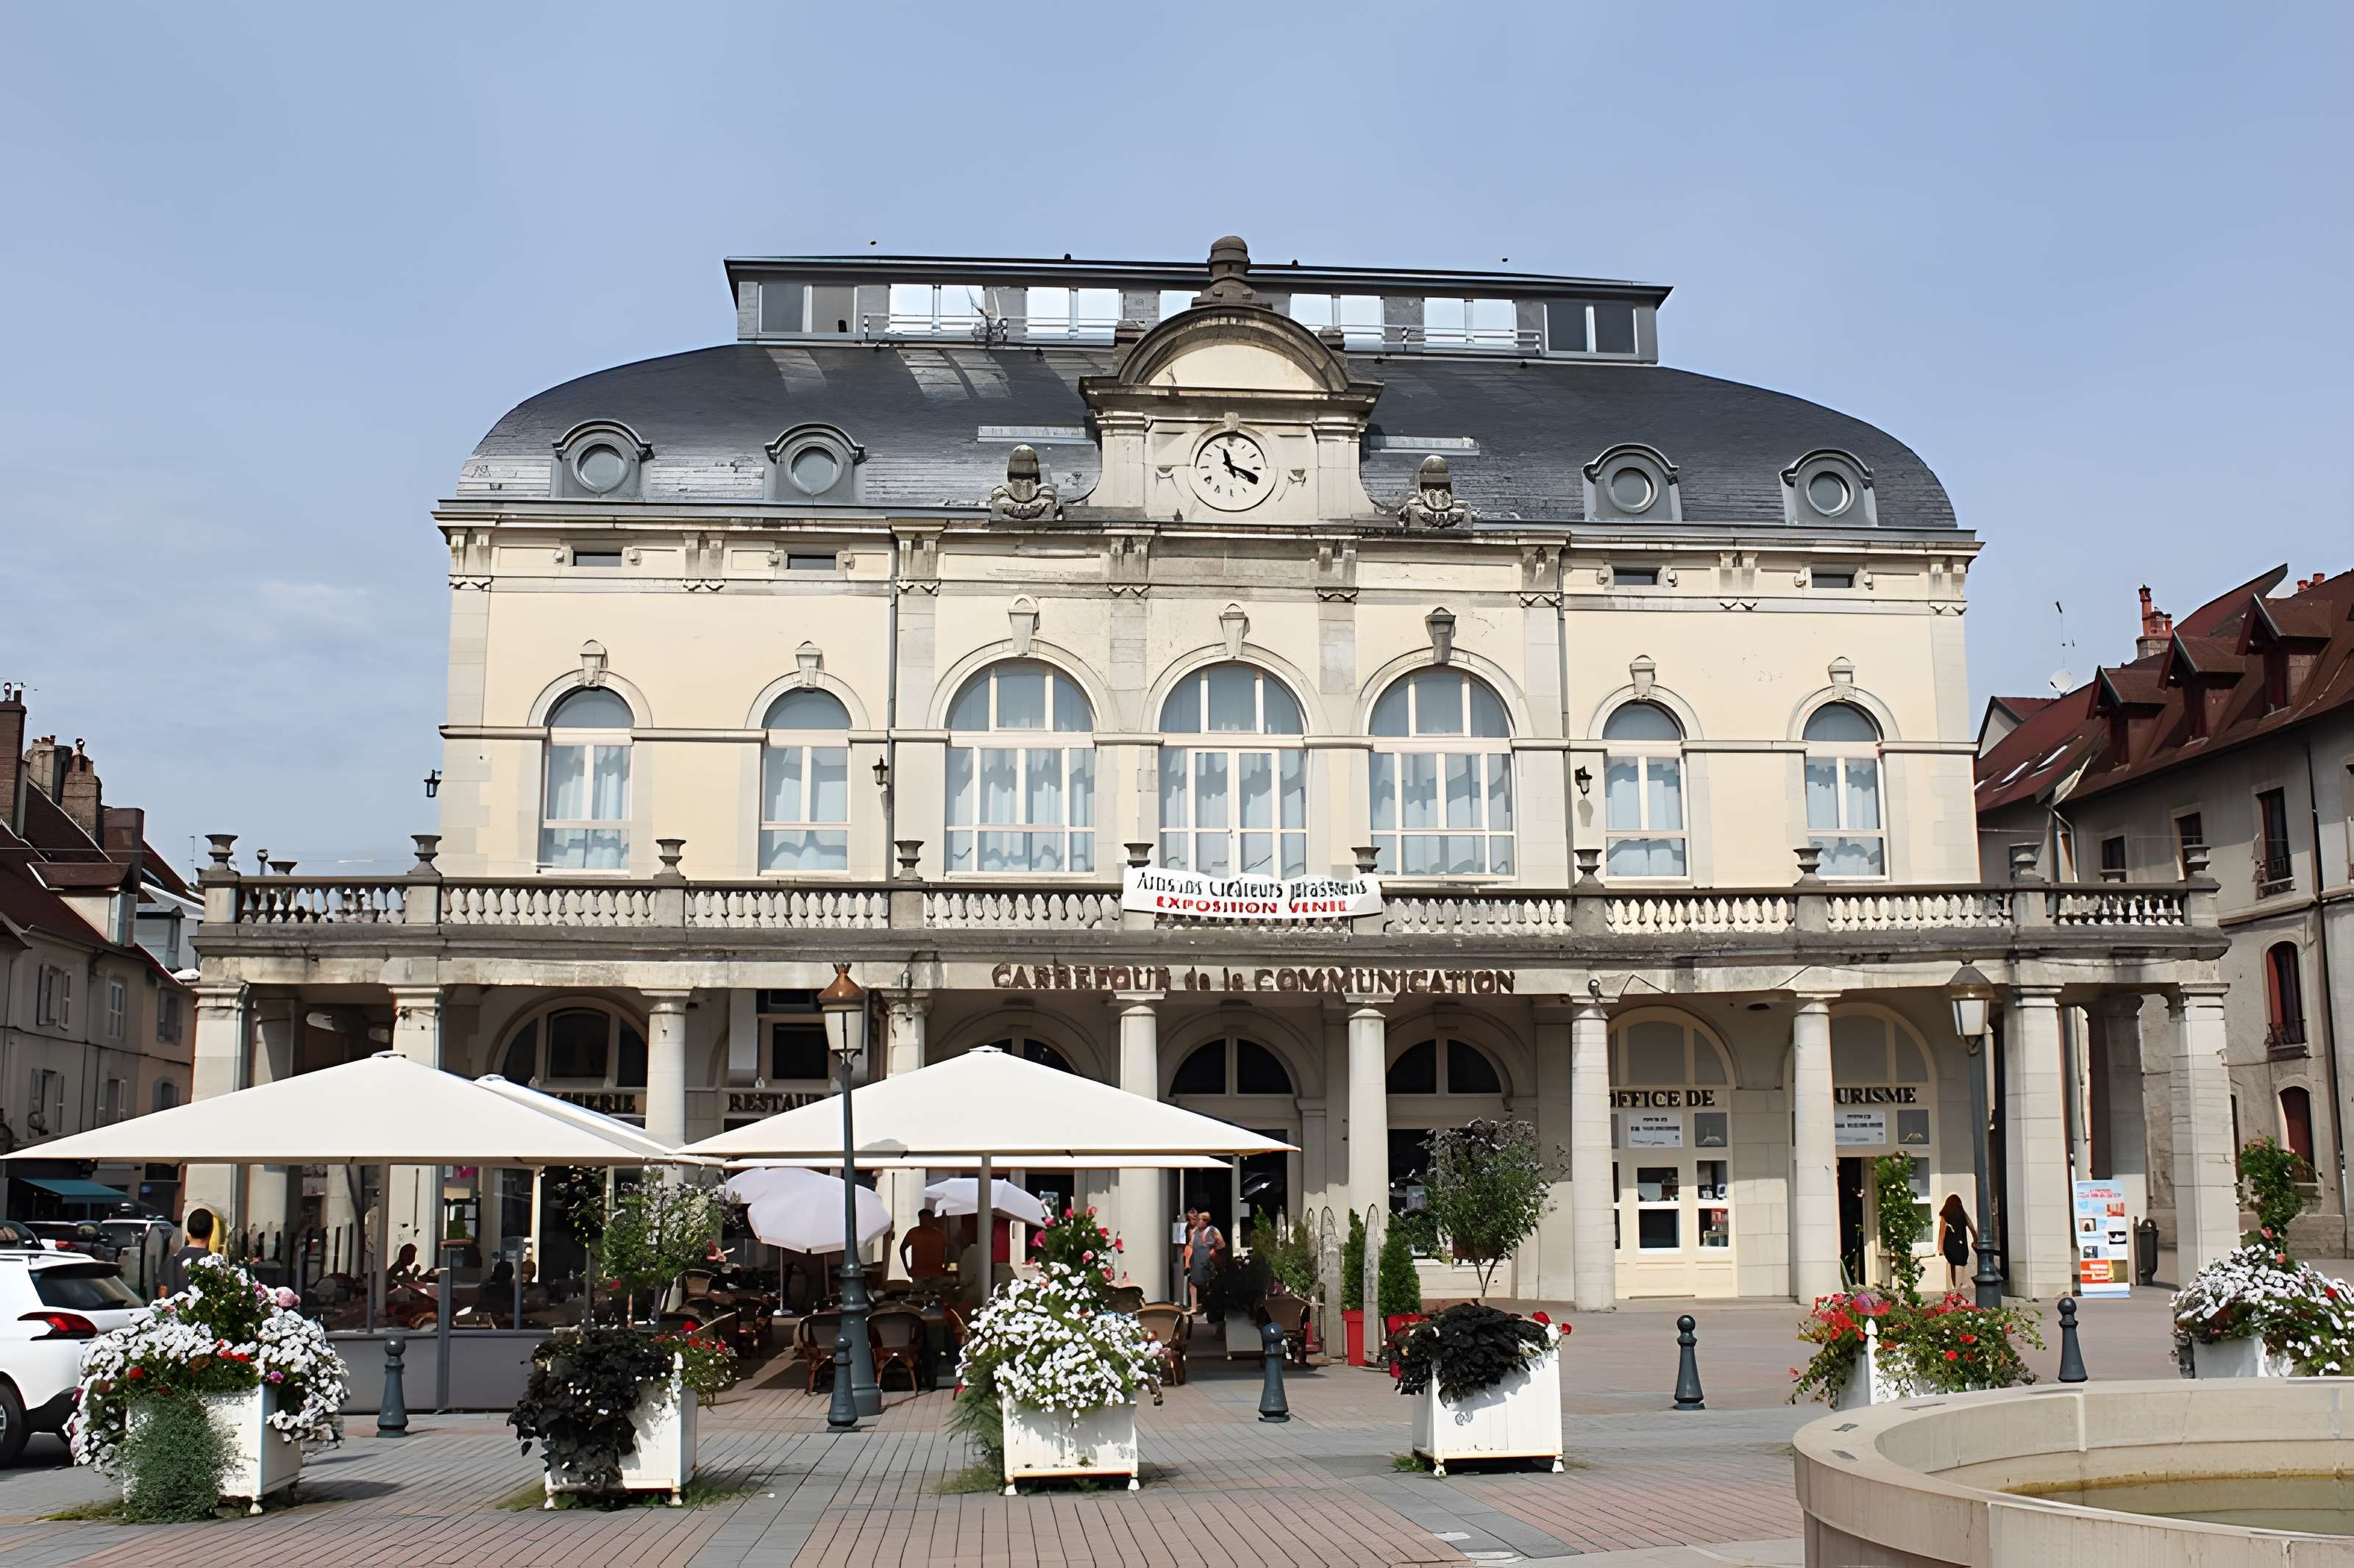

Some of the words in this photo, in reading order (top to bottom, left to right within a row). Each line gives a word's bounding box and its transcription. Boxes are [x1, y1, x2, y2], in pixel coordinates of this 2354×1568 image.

[1156, 896, 1277, 913] EXPOSITION
[992, 962, 1171, 990] CARREFOUR
[1255, 968, 1515, 994] COMMUNICATION
[1686, 1090, 1715, 1107] DE
[1835, 1087, 1916, 1104] URISME
